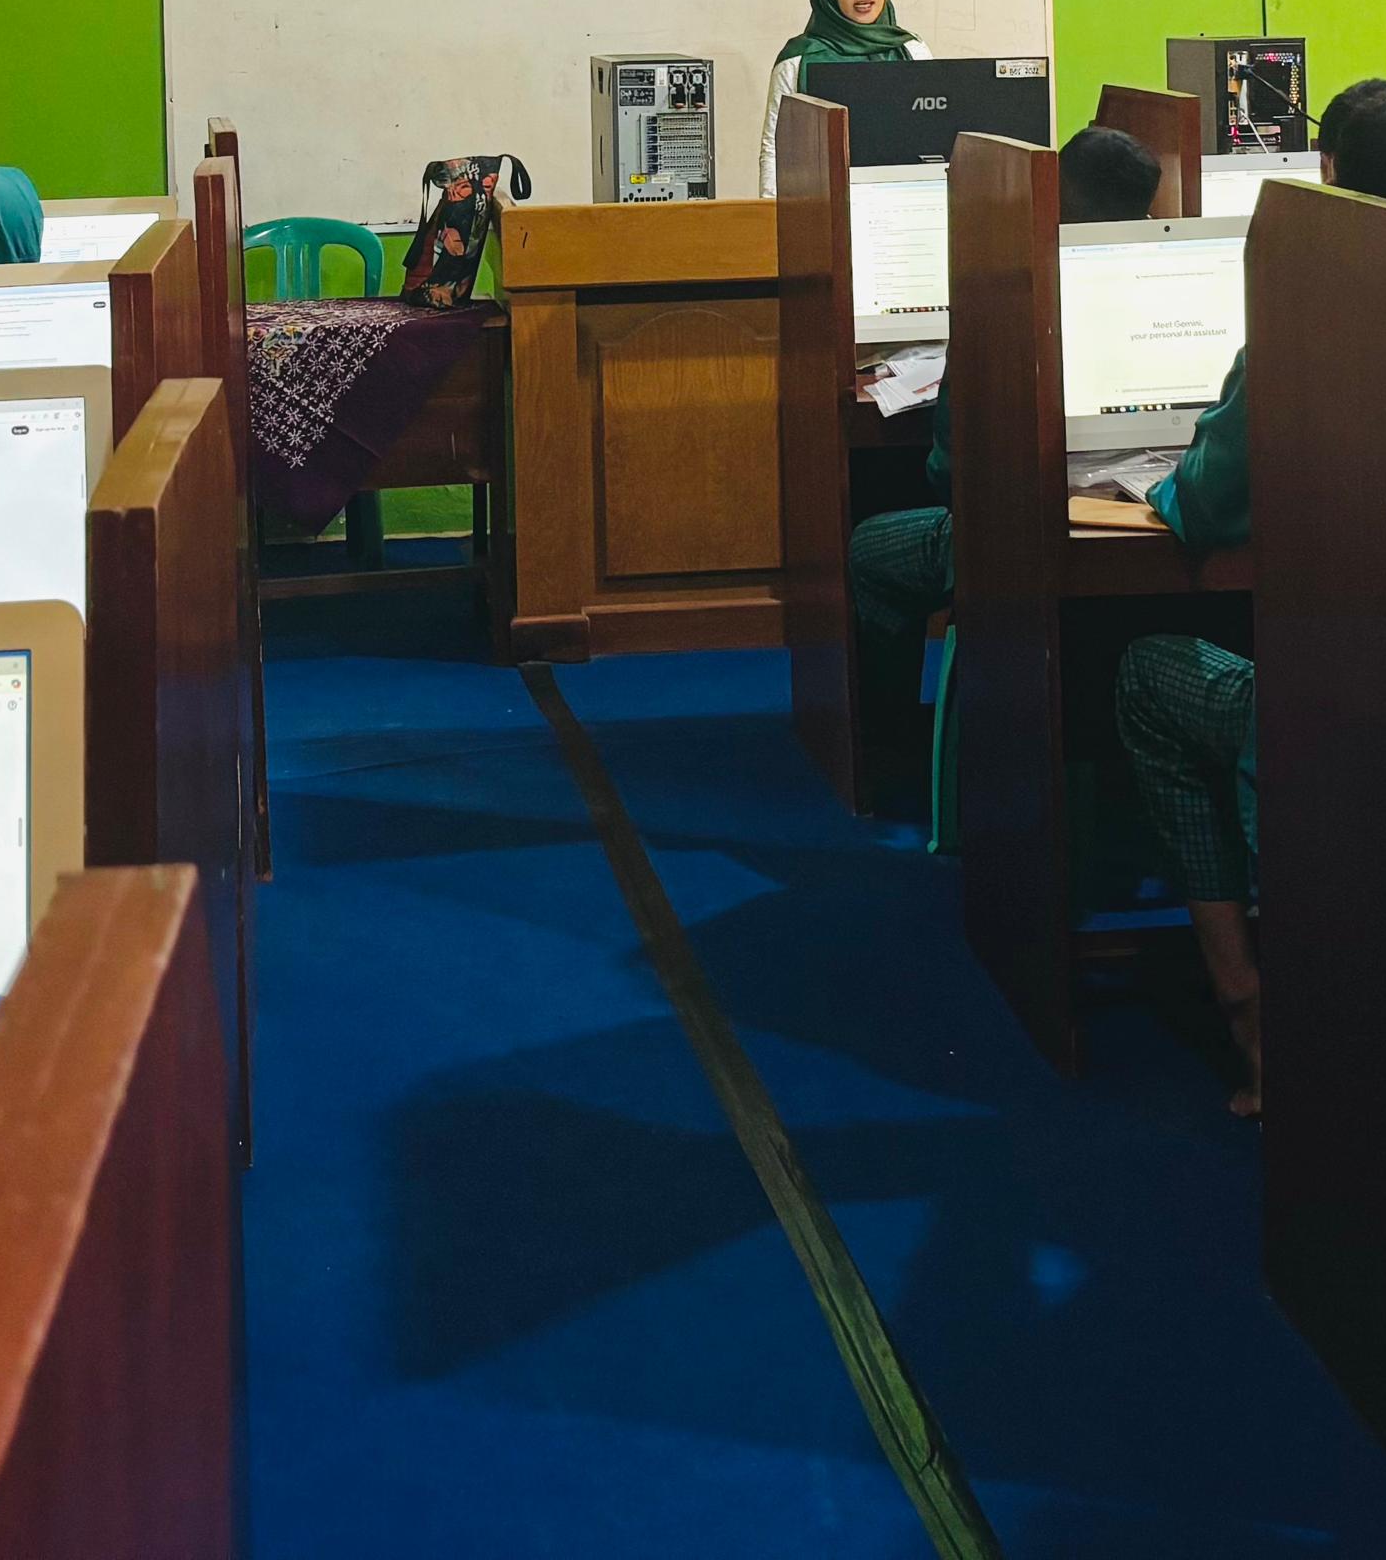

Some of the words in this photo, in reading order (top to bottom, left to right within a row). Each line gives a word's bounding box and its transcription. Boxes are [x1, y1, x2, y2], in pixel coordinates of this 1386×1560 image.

[912, 96, 948, 111] AOC
[1153, 321, 1173, 329] Meet
[1130, 332, 1148, 342] your
[1149, 330, 1183, 341] personal
[1184, 329, 1192, 337] AI
[1193, 327, 1227, 337] assistant
